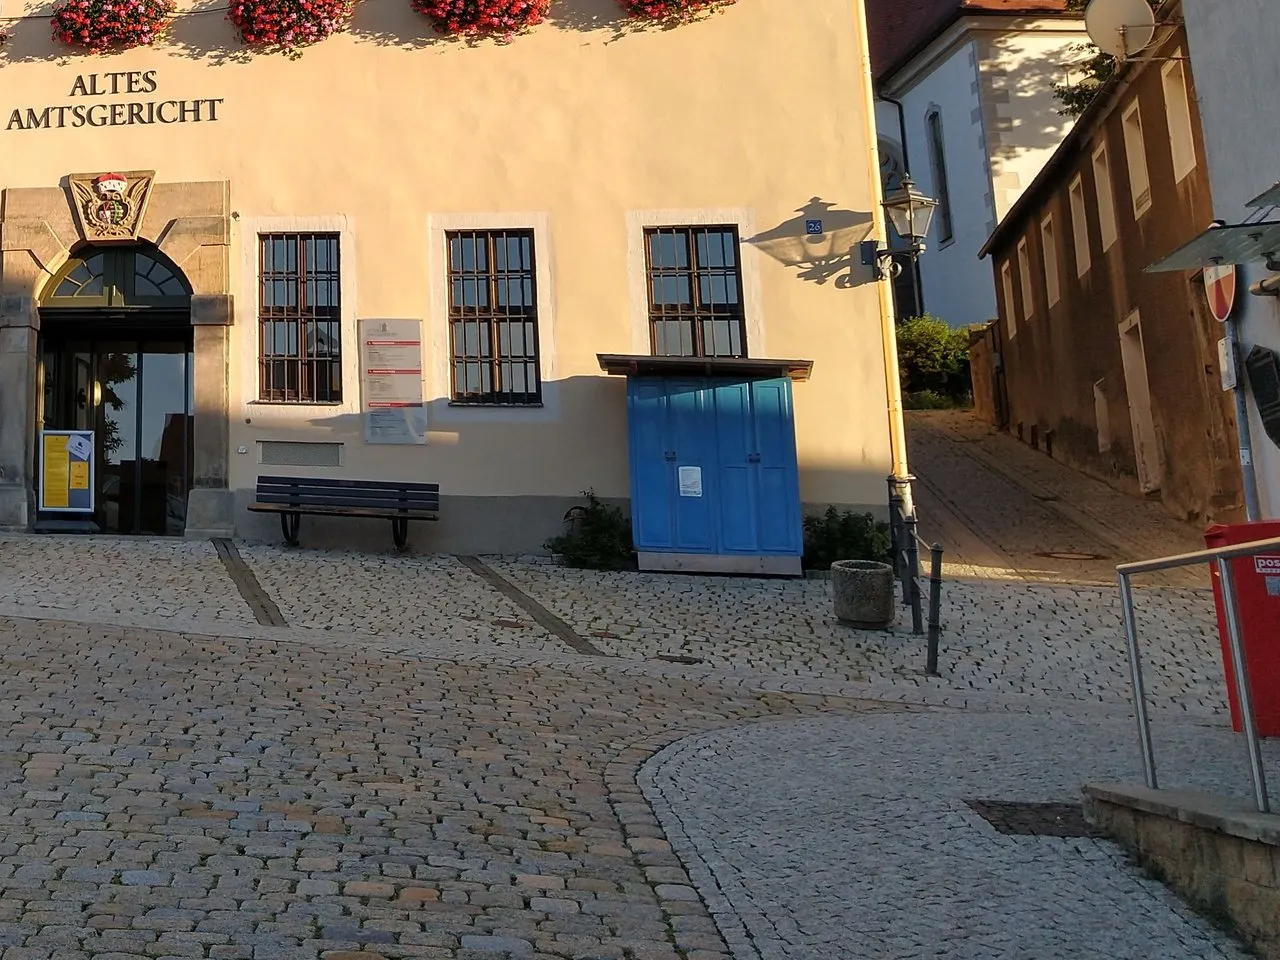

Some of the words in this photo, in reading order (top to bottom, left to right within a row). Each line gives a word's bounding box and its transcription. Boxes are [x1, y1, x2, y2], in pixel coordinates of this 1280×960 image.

[68, 70, 157, 97] ALTES
[5, 98, 224, 130] AMTSGERICHT
[809, 222, 821, 231] 26
